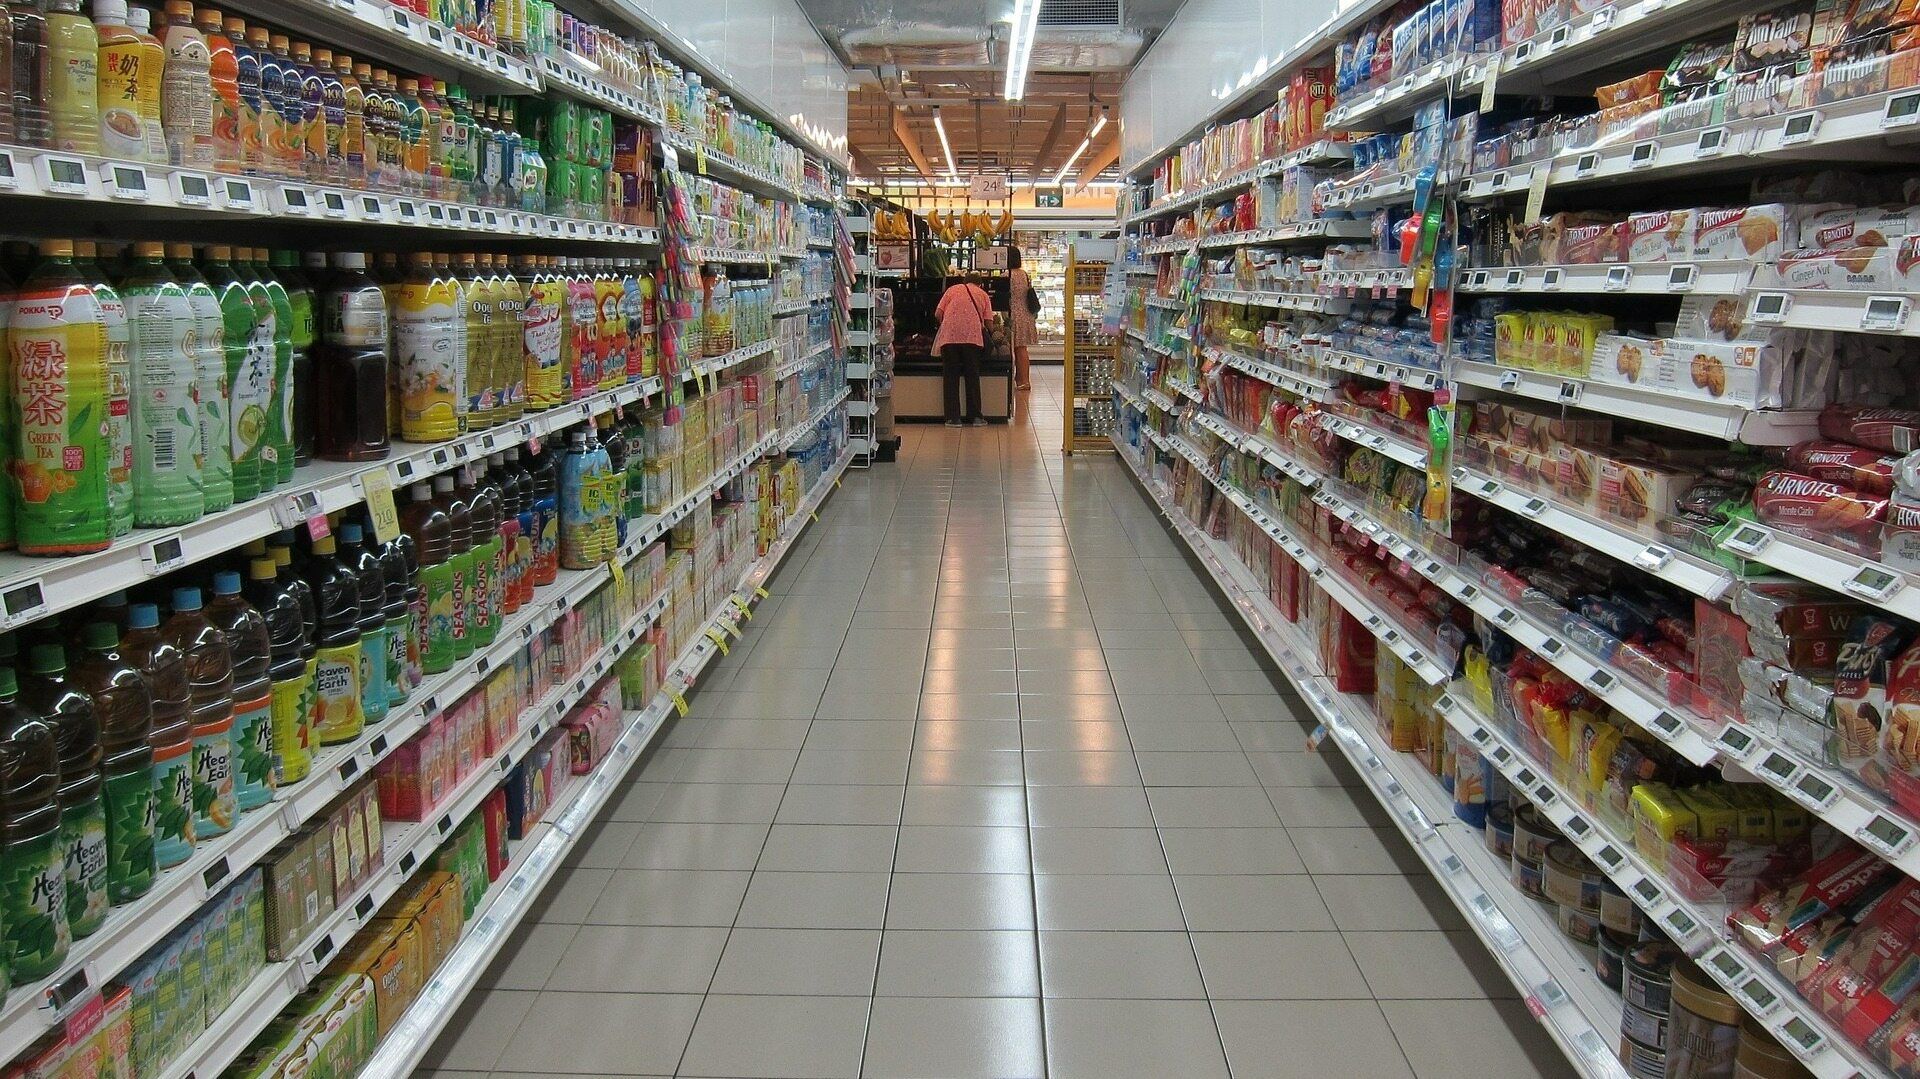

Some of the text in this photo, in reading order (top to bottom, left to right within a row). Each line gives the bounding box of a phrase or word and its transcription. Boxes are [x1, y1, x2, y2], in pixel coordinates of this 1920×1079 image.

[1311, 85, 1325, 97] RITZ
[1792, 264, 1830, 283] Ginger Nut
[20, 307, 45, 315] POKKA
[1778, 505, 1814, 517] Monte Carlo
[477, 560, 489, 627] SEASONS
[453, 571, 465, 639] SEASONS
[317, 678, 348, 692] Earth
